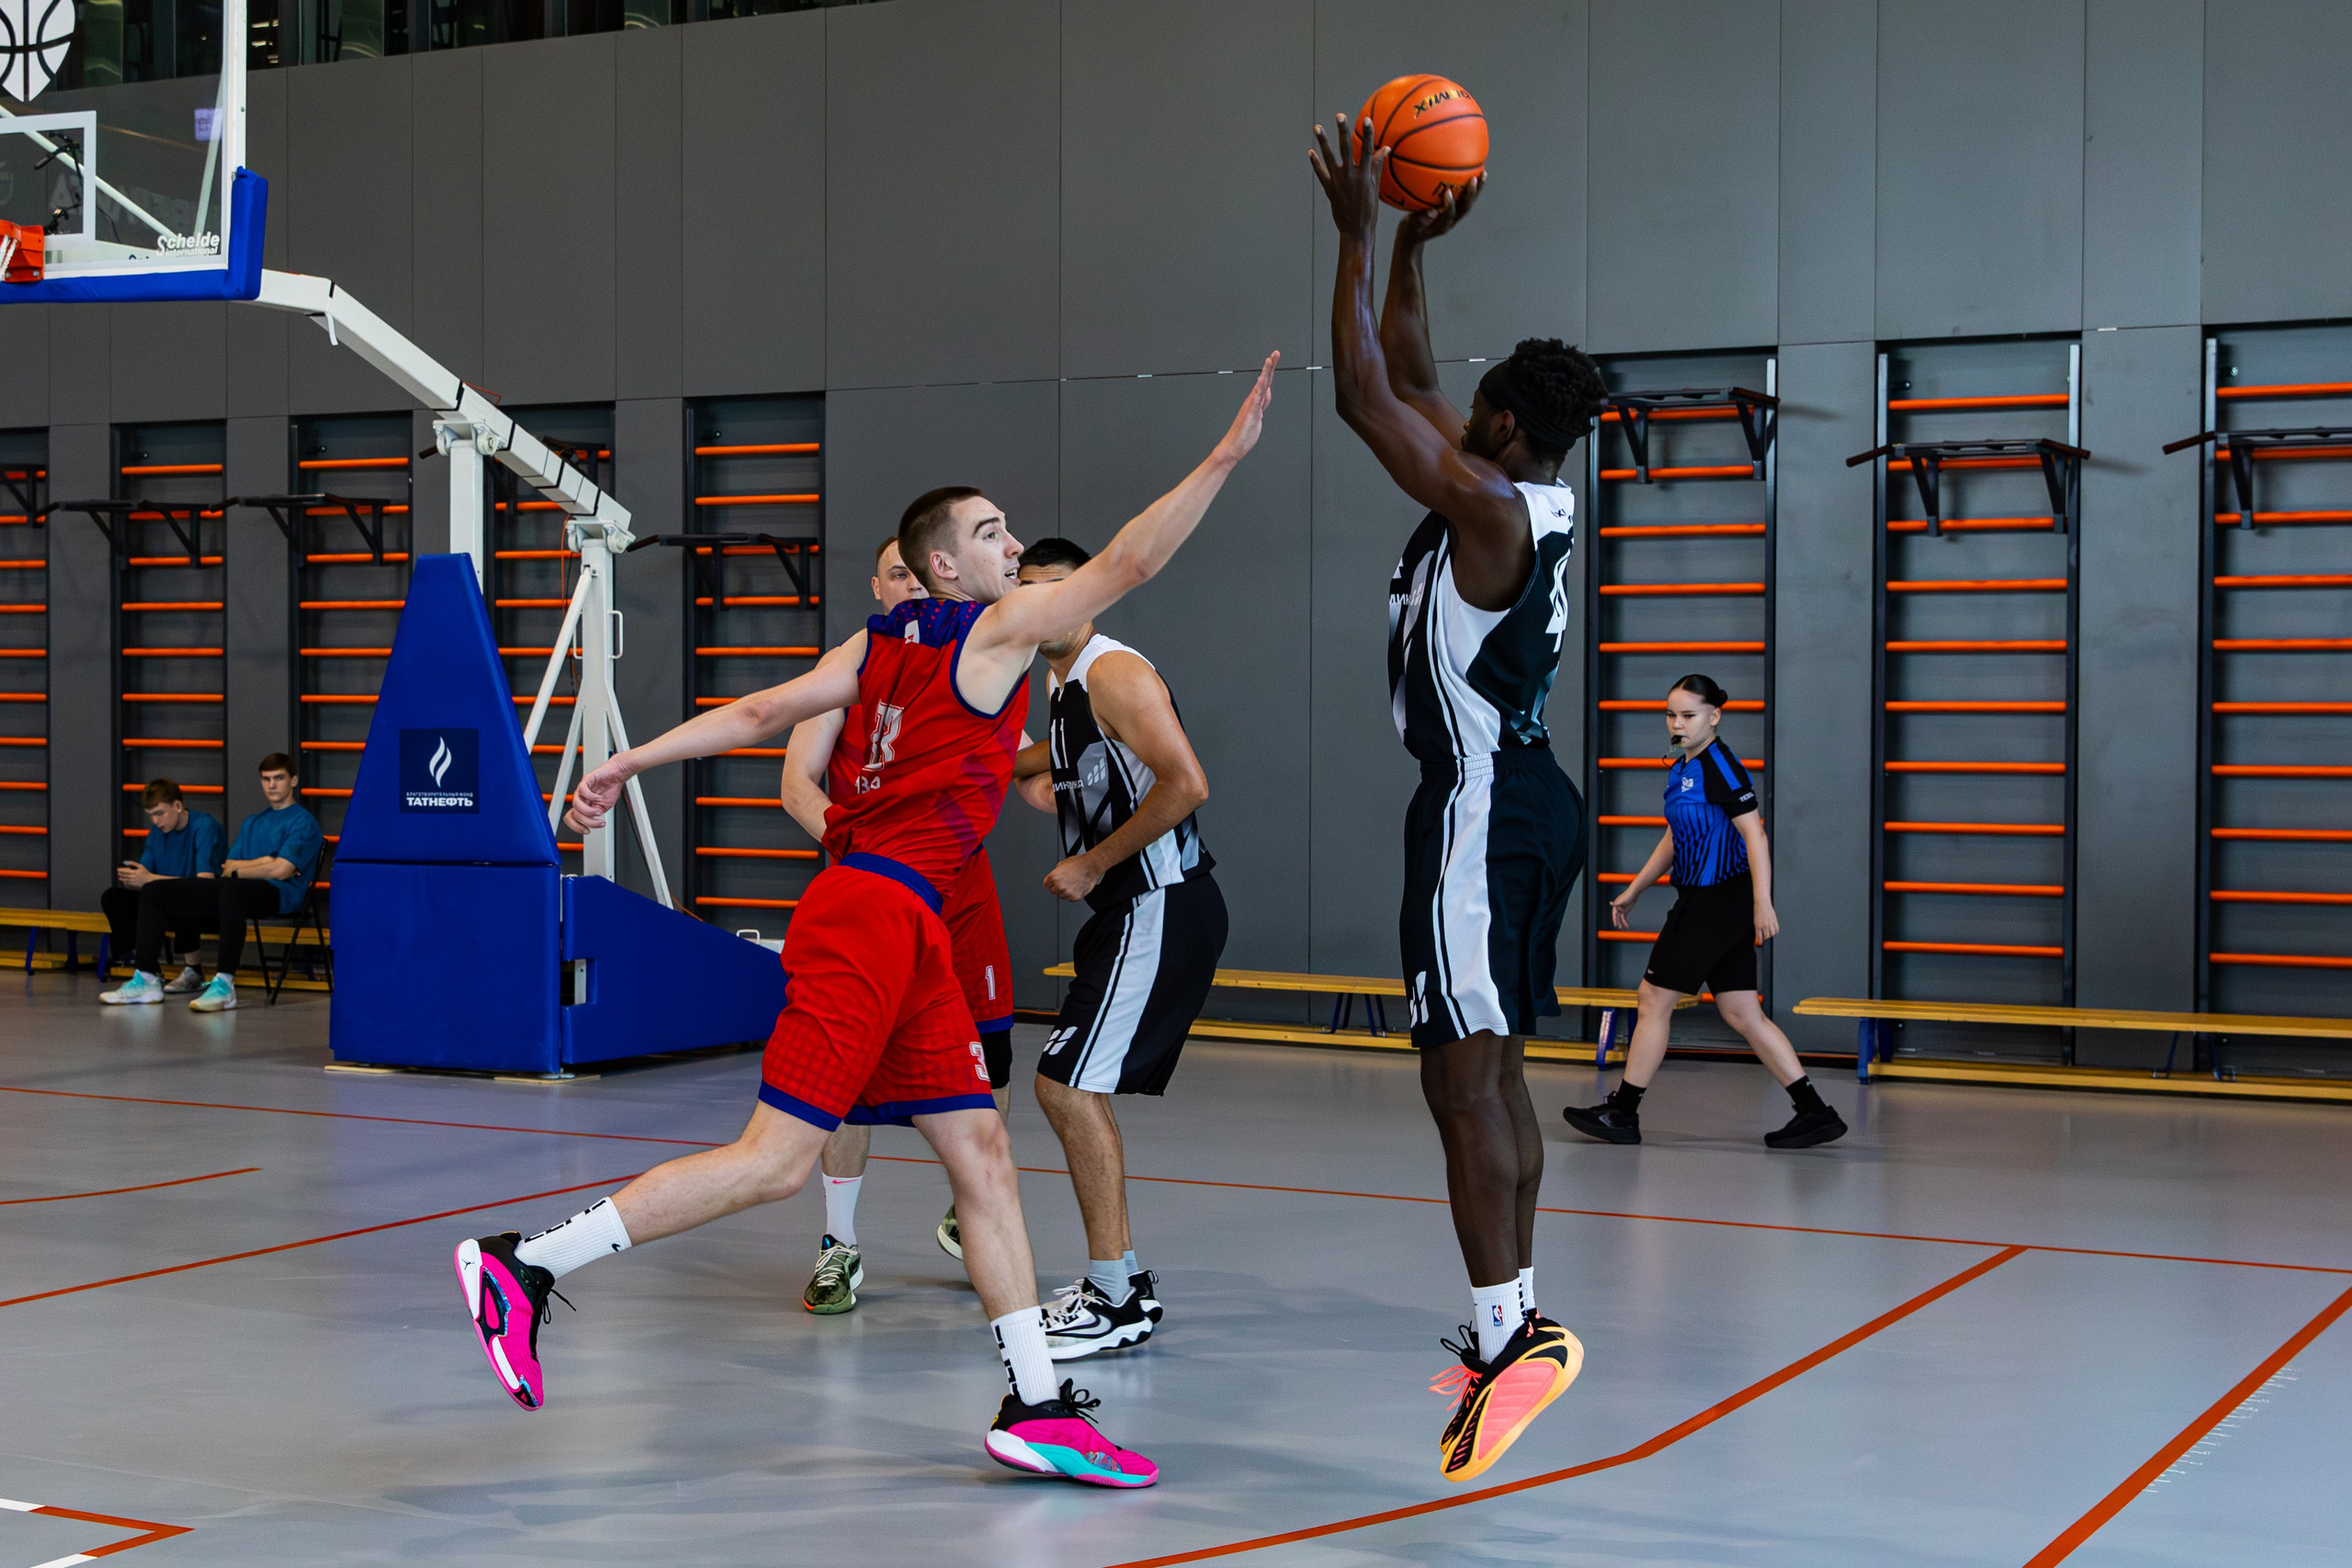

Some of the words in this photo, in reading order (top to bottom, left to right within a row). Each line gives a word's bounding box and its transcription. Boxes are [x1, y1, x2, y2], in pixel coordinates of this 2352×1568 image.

[156, 231, 220, 256] Schelde
[165, 245, 219, 257] international
[406, 797, 473, 807] ТАТНЕФТЬ
